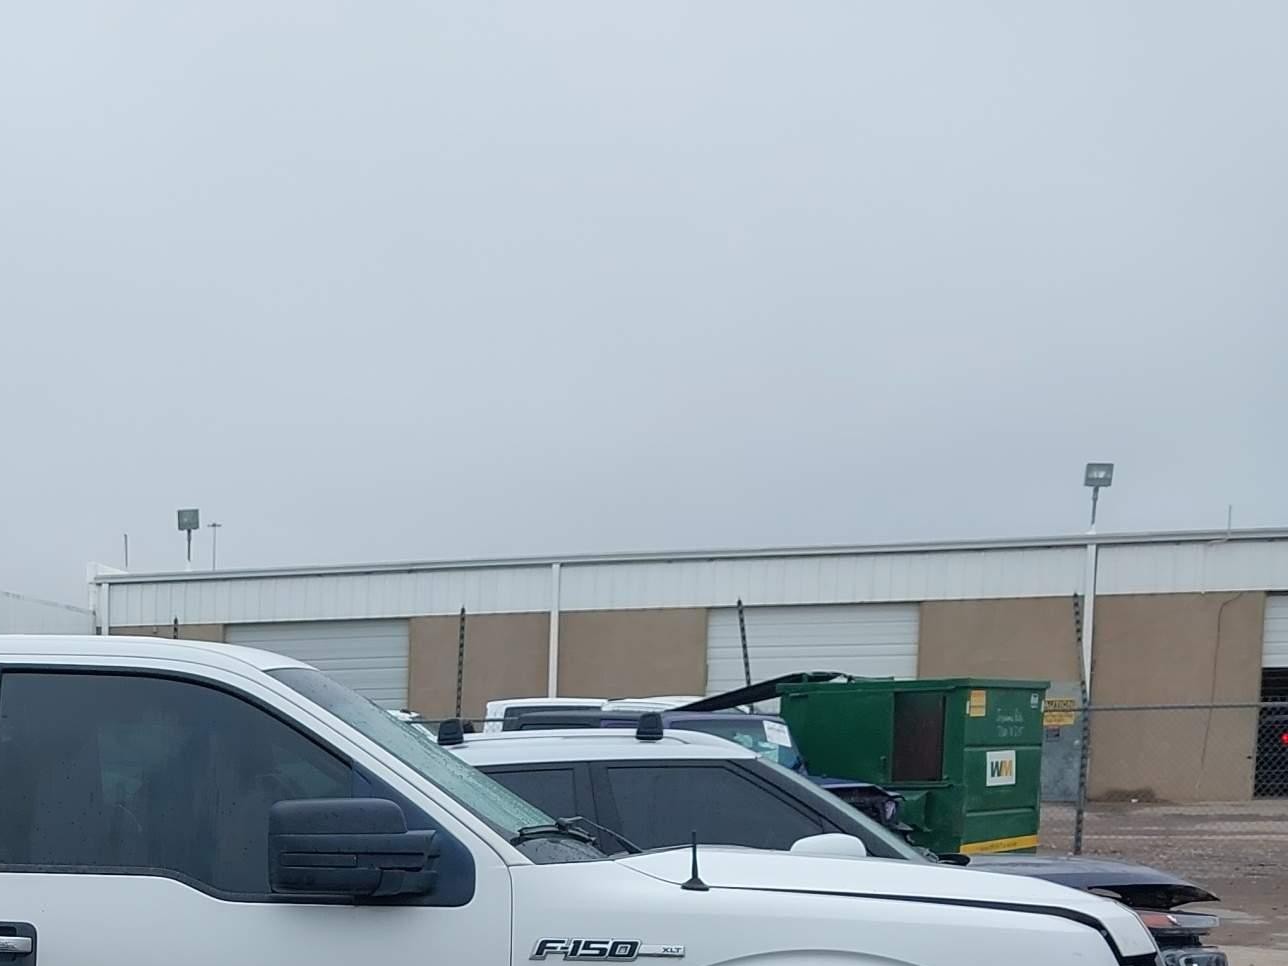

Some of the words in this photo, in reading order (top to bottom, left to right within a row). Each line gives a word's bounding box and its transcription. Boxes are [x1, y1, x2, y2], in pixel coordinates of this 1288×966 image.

[990, 759, 1013, 778] WM
[530, 938, 641, 961] F-150
[662, 946, 682, 954] XLT
